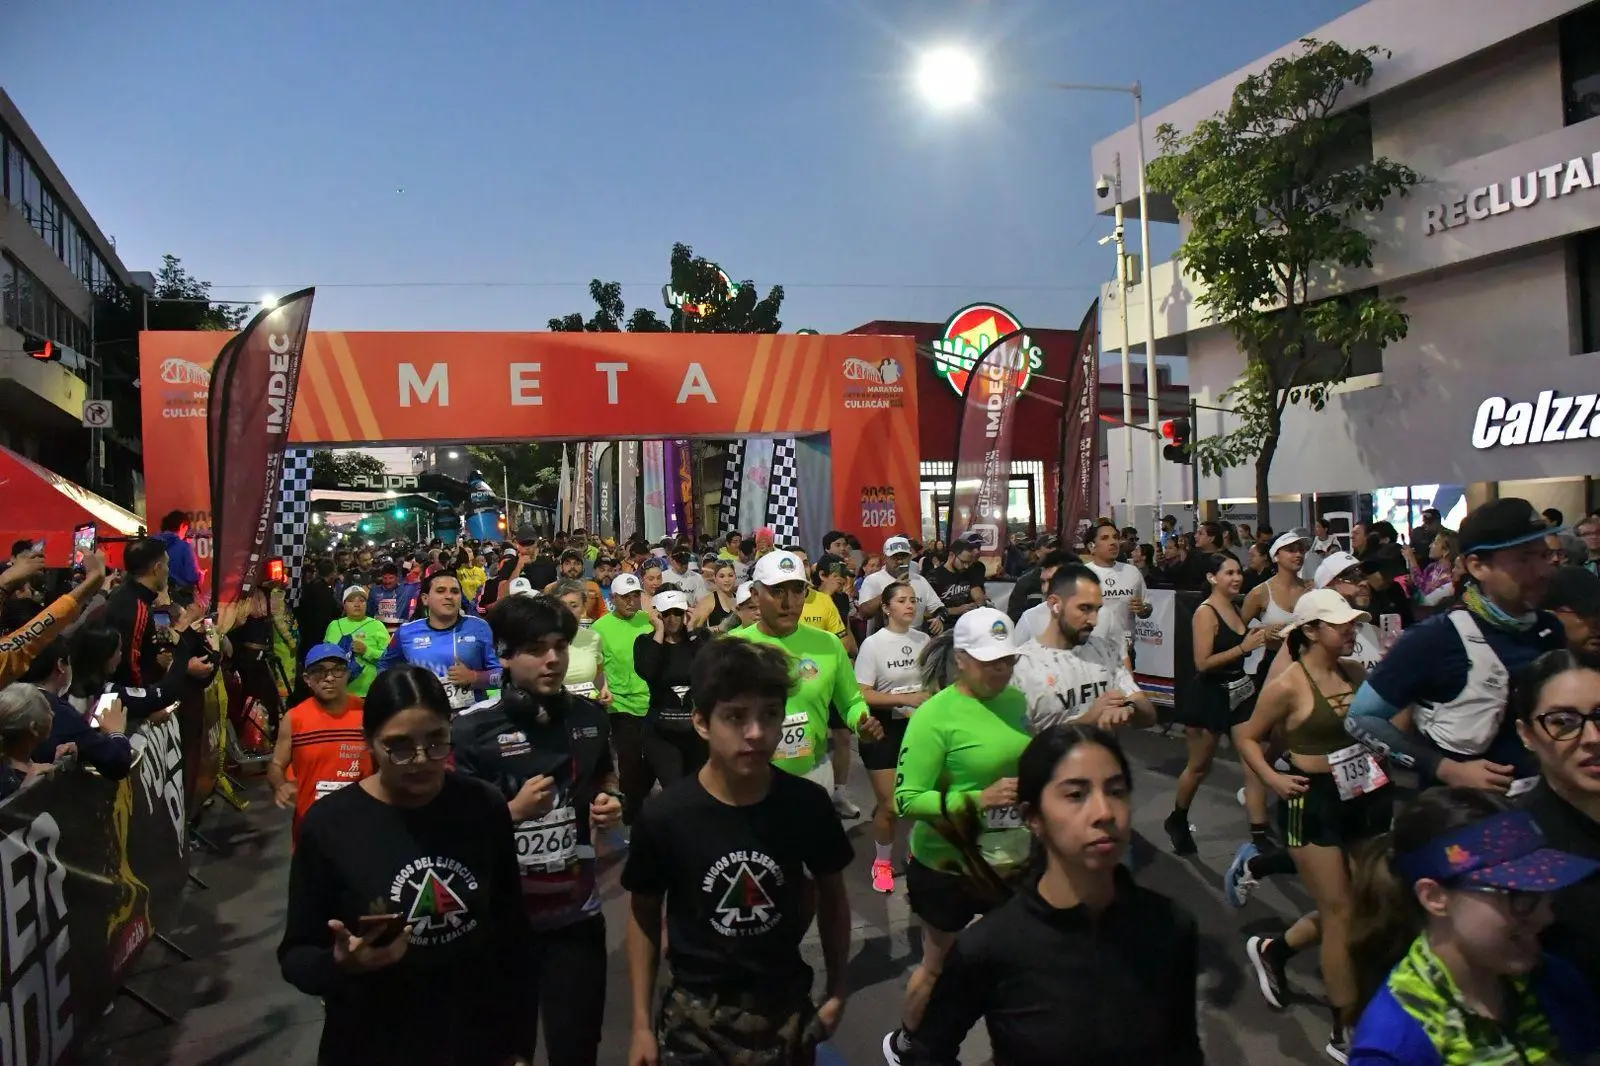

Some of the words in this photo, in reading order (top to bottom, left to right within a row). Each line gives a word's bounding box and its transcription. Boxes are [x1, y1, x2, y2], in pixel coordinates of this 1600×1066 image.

[1422, 152, 1600, 235] RECLUTA
[266, 333, 290, 434] IMDEC
[398, 361, 717, 407] META
[867, 384, 904, 393] MARATÓN
[162, 408, 208, 418] CULIAC
[845, 398, 890, 409] CULIACÁN
[985, 365, 1004, 438] IMDEC
[341, 499, 398, 511] SALIDA
[862, 509, 897, 527] 2026
[1080, 680, 1108, 705] FIT
[390, 864, 415, 902] AMIGOS
[414, 856, 435, 871] DEL
[436, 856, 479, 890] EJERCITO
[702, 856, 730, 893] AMIGOS
[729, 850, 750, 864] DEL
